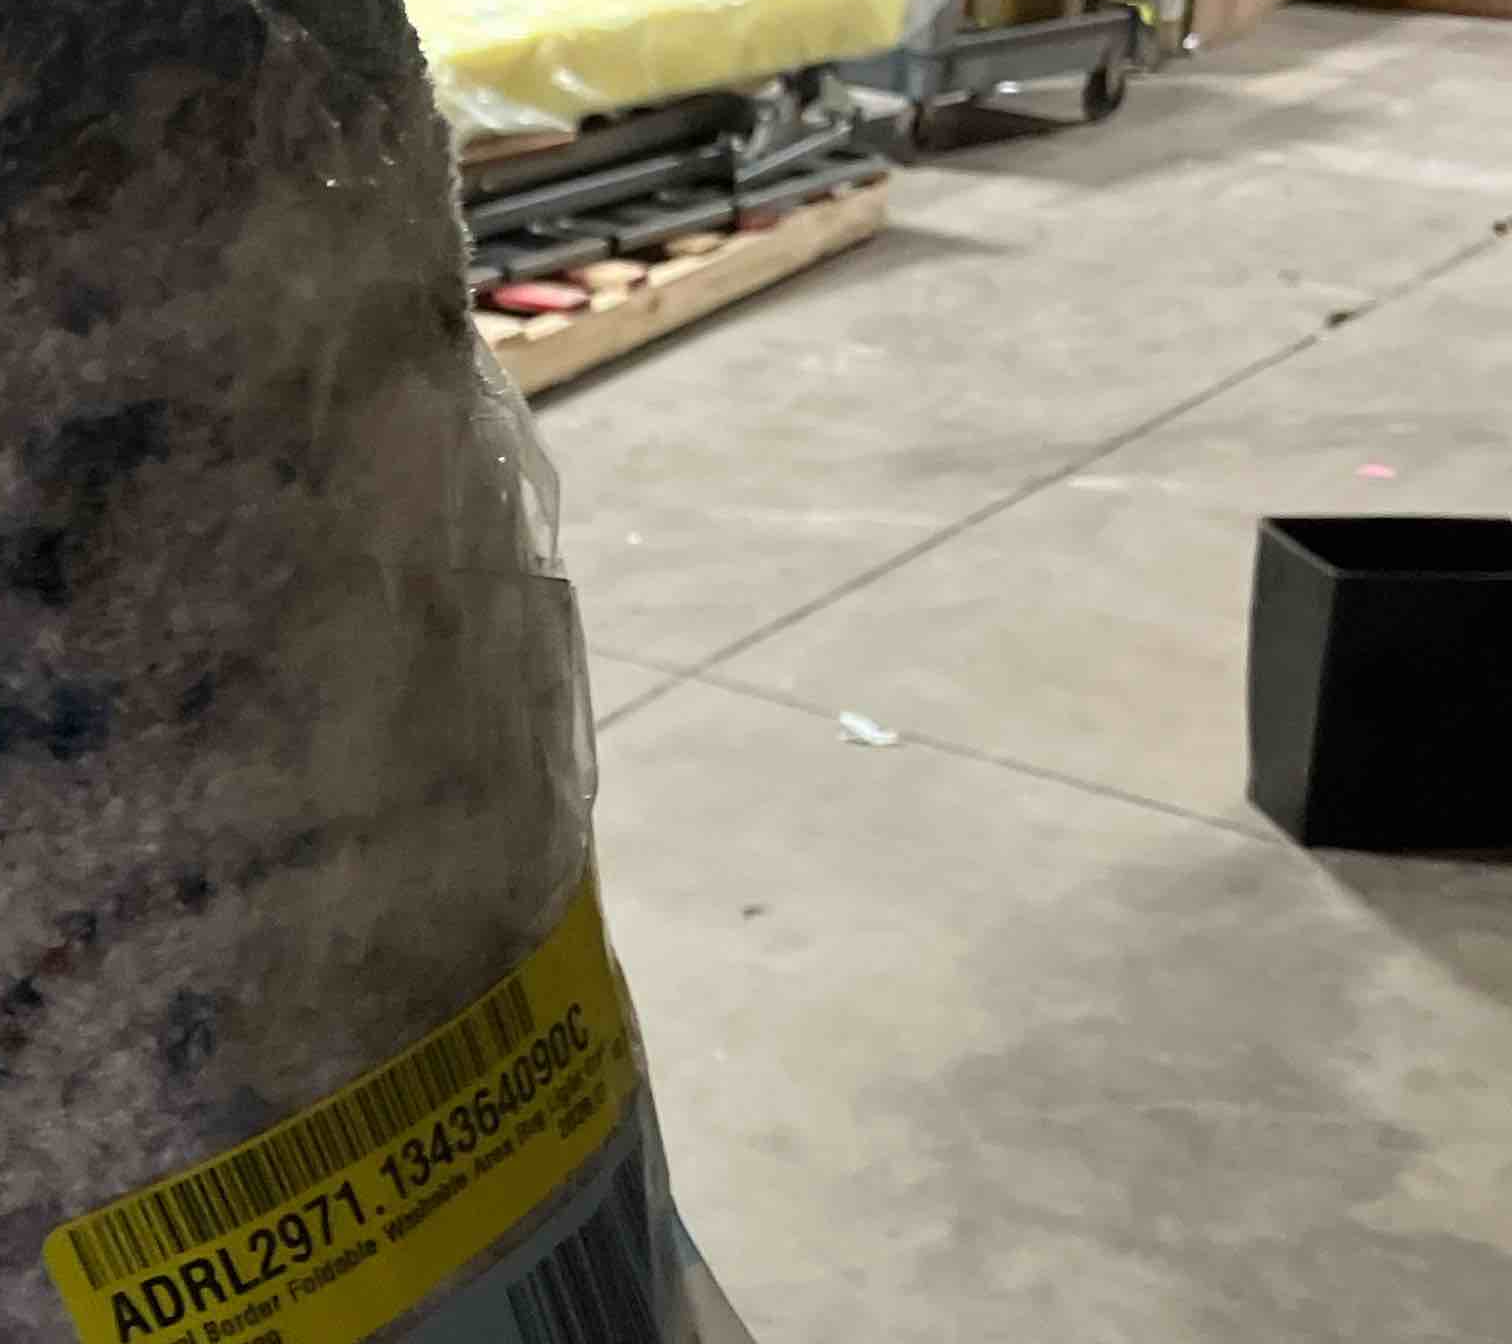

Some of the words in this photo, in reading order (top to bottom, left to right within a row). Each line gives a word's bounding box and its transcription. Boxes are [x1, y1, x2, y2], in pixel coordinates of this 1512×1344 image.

[110, 1001, 591, 1344] ADRL2971.134364090C
[203, 1295, 282, 1344] Border
[287, 1238, 379, 1304] Foldable
